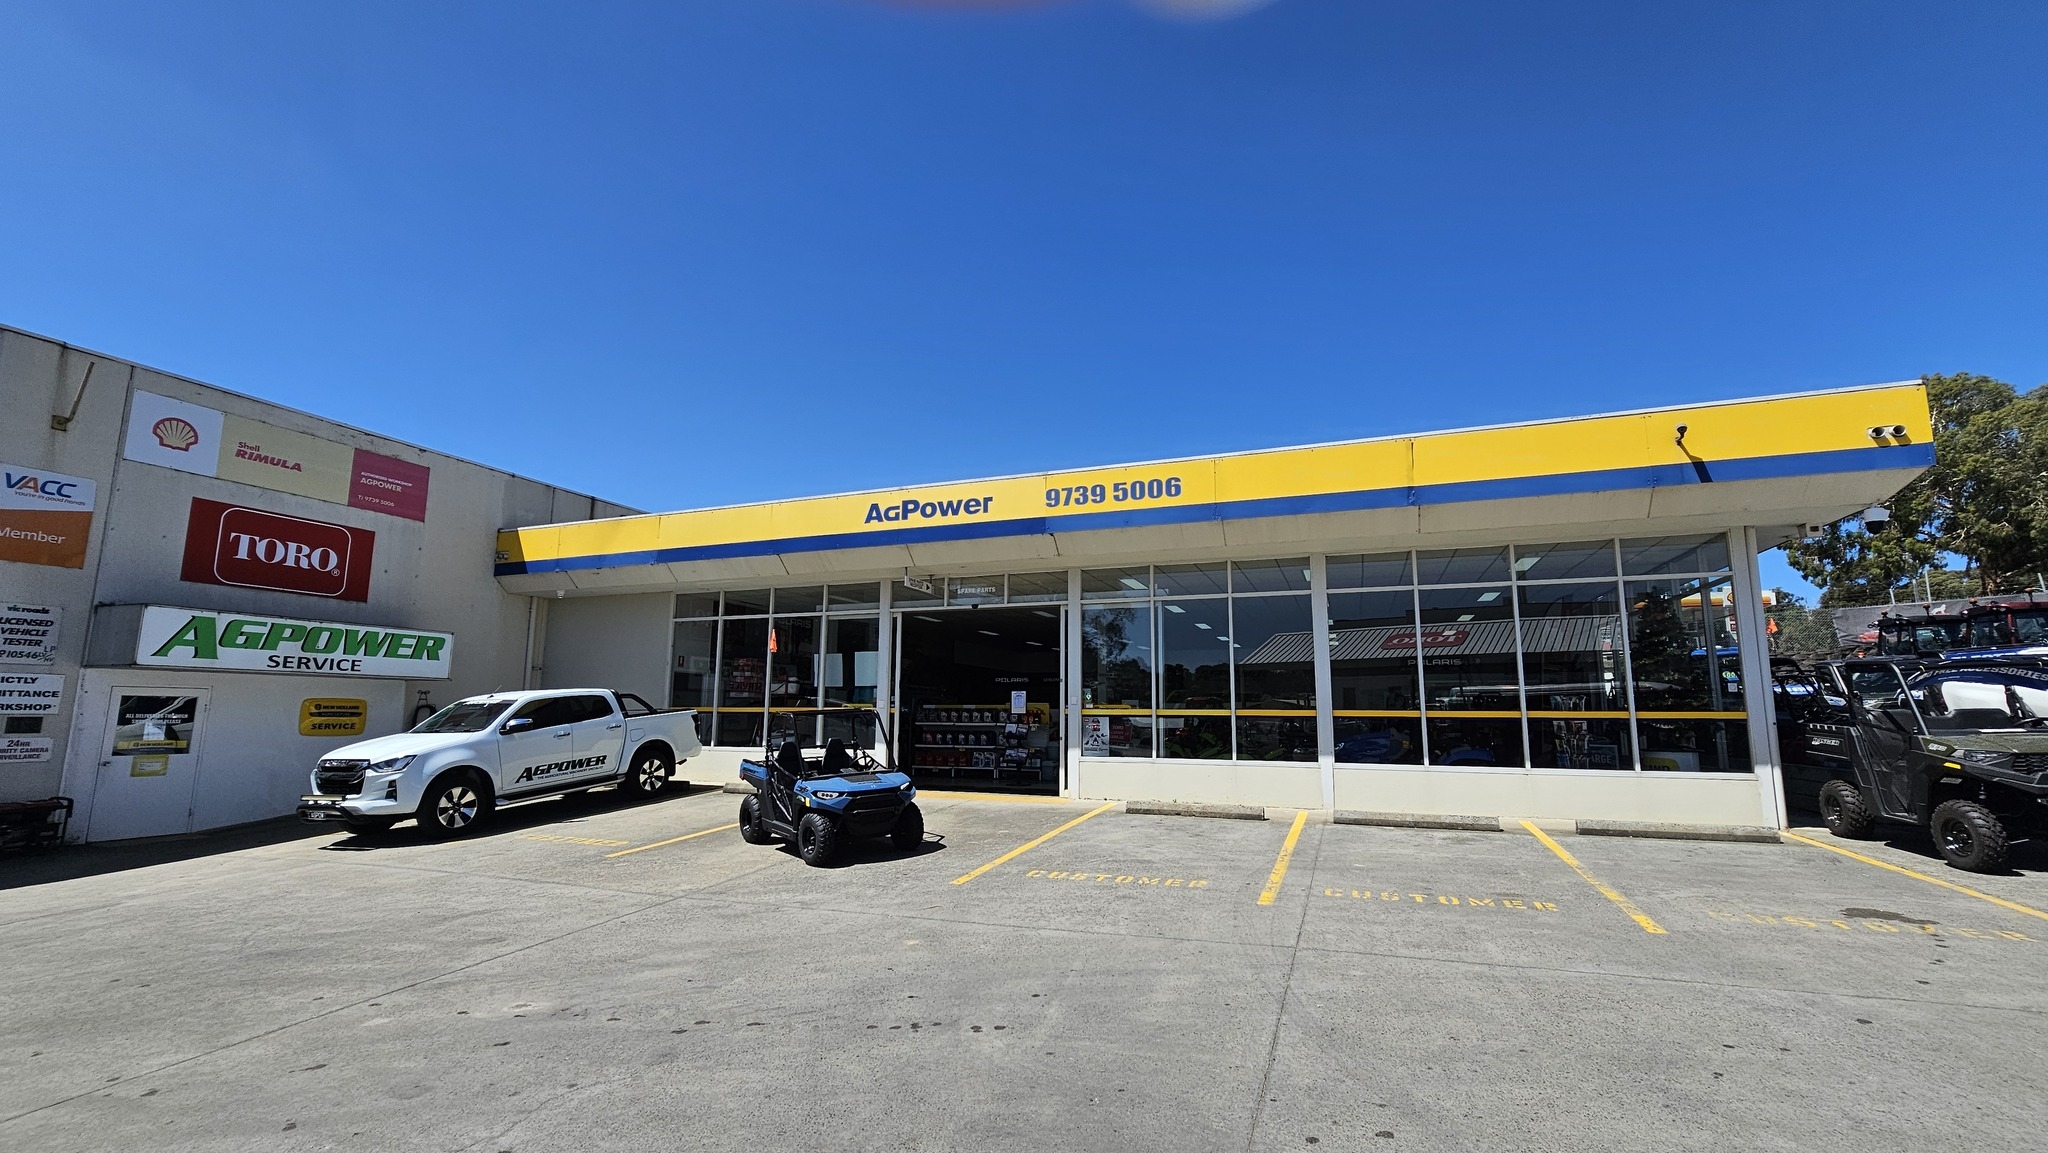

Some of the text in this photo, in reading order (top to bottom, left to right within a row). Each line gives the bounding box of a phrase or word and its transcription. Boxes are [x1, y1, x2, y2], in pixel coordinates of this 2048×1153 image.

[238, 441, 260, 453] Shell
[235, 449, 302, 472] RIMULA
[5, 472, 77, 498] VACC
[360, 477, 402, 493] AGPOWER
[1045, 476, 1182, 508] 9739 5006
[364, 496, 380, 504] 9739
[229, 531, 339, 572] TORO
[976, 586, 996, 594] PARTS
[0, 616, 54, 627] LICENSED
[774, 618, 812, 629] OLARIS
[1, 627, 49, 637] VEHICLE
[150, 615, 446, 661] AGPOWER
[3, 637, 43, 647] TESTER
[266, 654, 362, 673] SERVICE
[514, 755, 607, 784] AGPOWER
[1027, 869, 1208, 888] CUSTOMER
[1325, 887, 1560, 912] CUSTOMER
